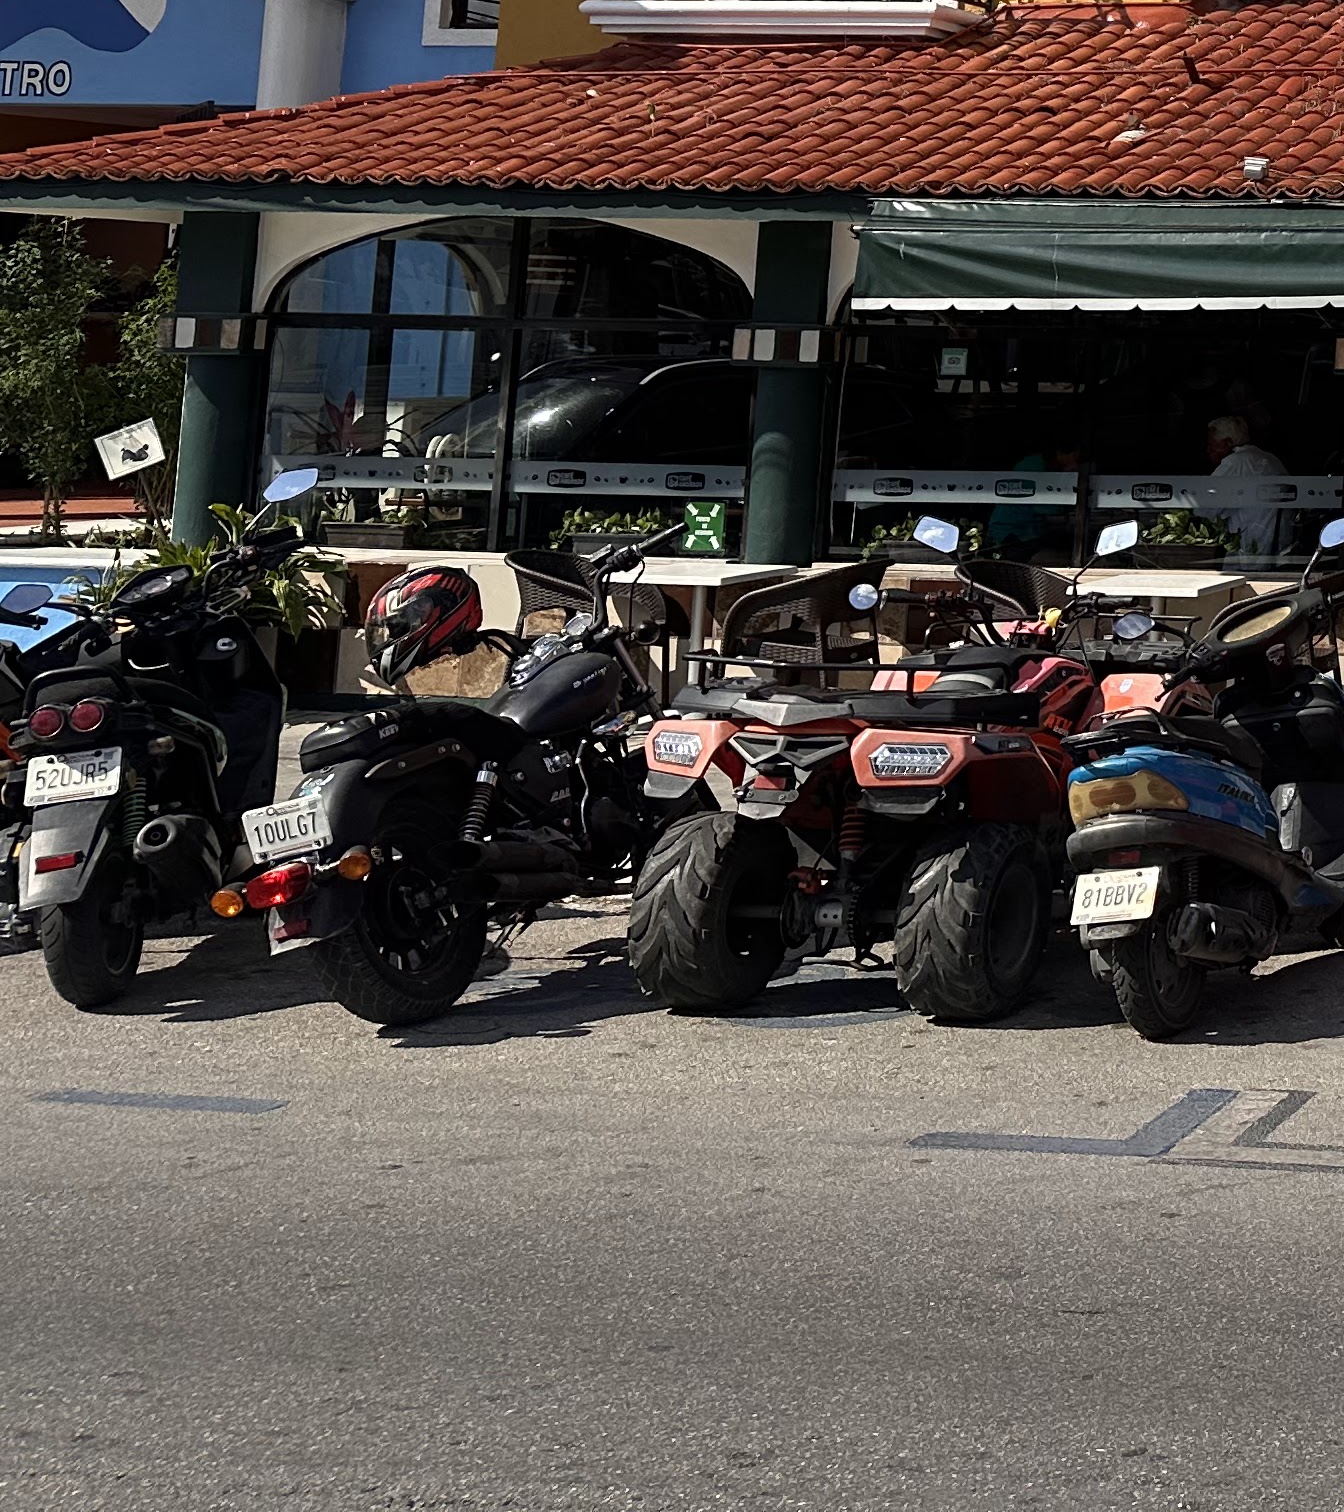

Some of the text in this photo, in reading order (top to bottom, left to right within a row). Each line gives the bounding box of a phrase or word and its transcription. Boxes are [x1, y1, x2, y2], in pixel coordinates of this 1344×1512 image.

[0, 60, 73, 97] TRO
[36, 761, 108, 791] 52UJR5
[254, 812, 317, 848] 10ULG7
[1082, 883, 1147, 909] 81BBV2
